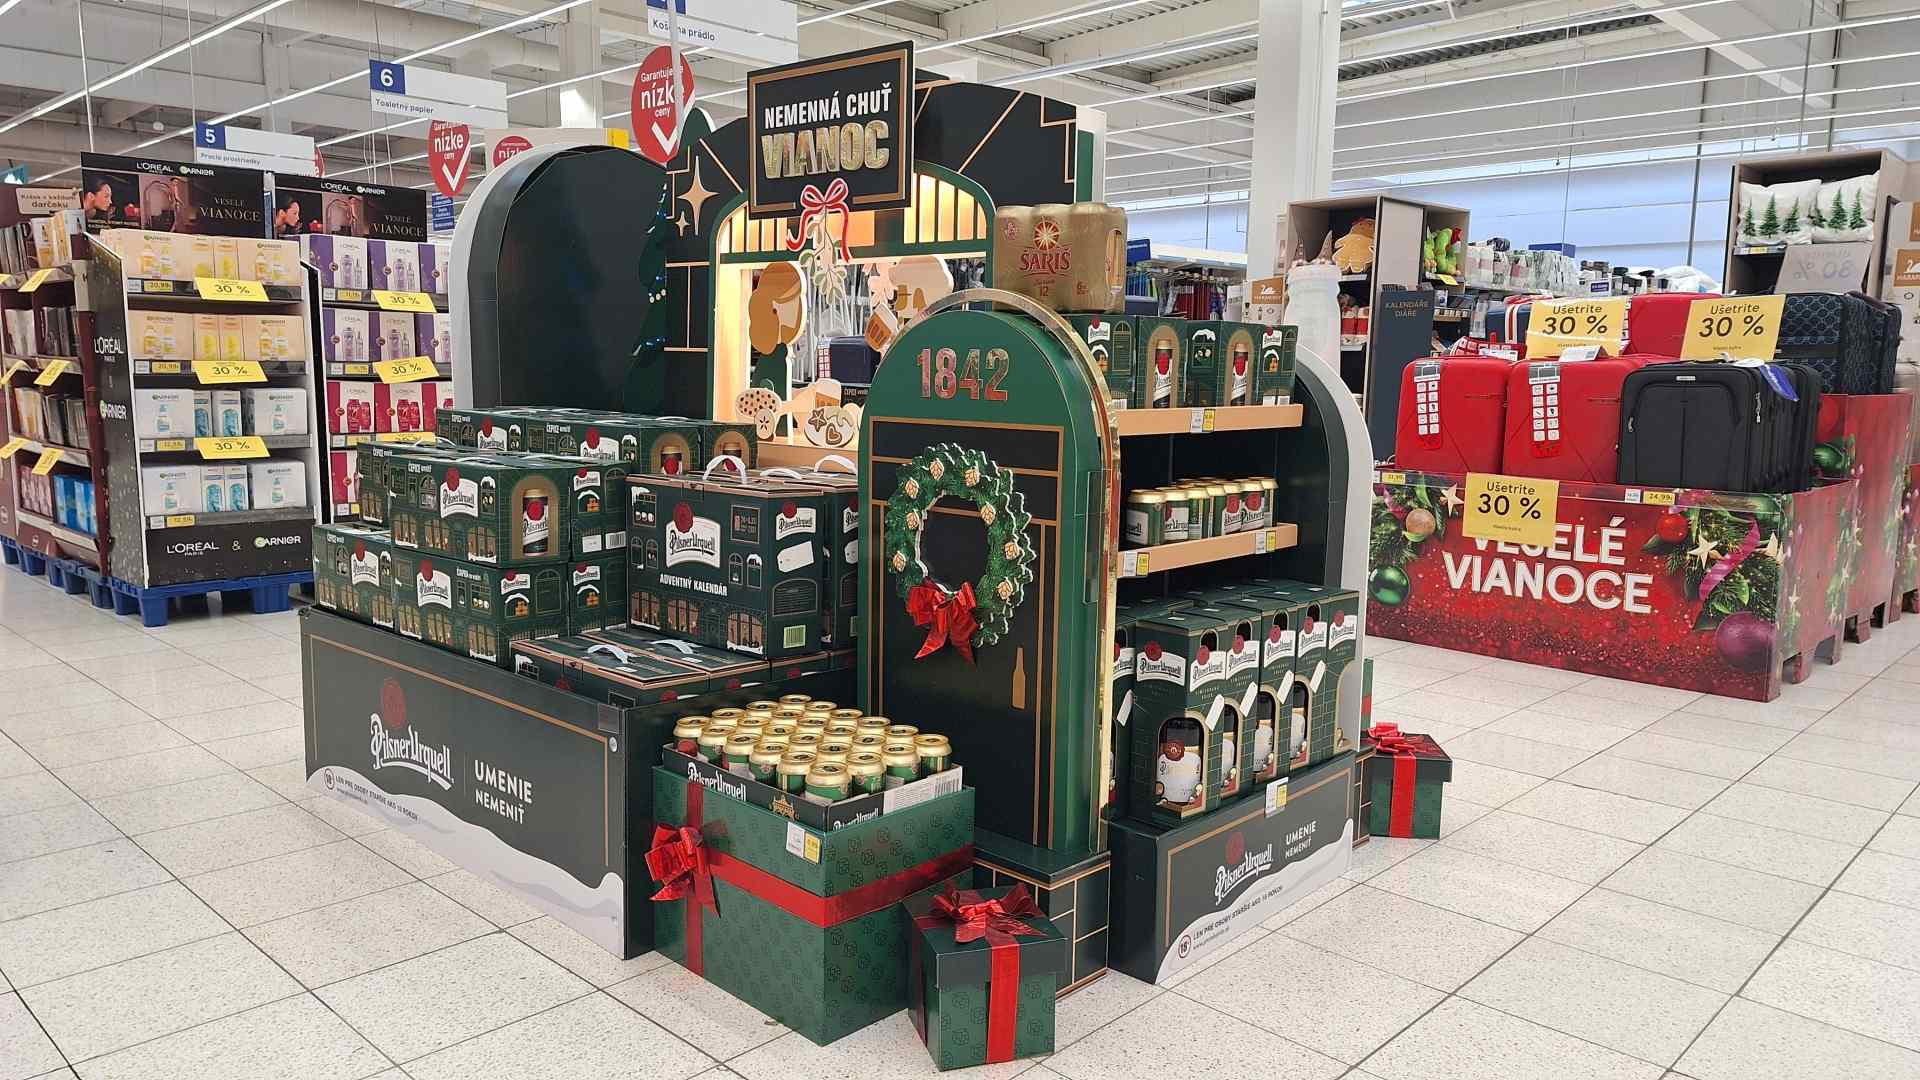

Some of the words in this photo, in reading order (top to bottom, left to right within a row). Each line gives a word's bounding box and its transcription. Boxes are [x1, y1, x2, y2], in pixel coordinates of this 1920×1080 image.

[688, 28, 715, 41] prádlo
[380, 68, 393, 87] 6
[641, 64, 683, 83] Garantujee
[410, 103, 434, 114] papier
[654, 107, 671, 119] ceny
[765, 91, 841, 129] NEMENNÁ
[846, 82, 892, 117] CHUŤ
[205, 129, 216, 144] 5
[761, 119, 890, 180] VIANOC
[200, 207, 261, 222] VIANOCE
[373, 223, 424, 237] VIANOCE
[1019, 247, 1072, 275] ŠARIŠ
[215, 284, 233, 294] 30
[237, 285, 251, 294] %
[390, 296, 405, 304] 30
[409, 296, 421, 304] %
[1553, 304, 1603, 315] Ušetrite
[1710, 303, 1760, 315] Ušetrite
[1543, 316, 1576, 335] 30
[1587, 315, 1608, 335] %
[1699, 316, 1733, 337] 30
[1743, 314, 1764, 336] %
[213, 366, 231, 376] 30
[235, 366, 248, 376] %
[391, 365, 407, 375] 30
[409, 363, 422, 371] %
[917, 347, 1010, 401] 1842
[215, 442, 233, 451] 30
[237, 441, 250, 451] %
[1487, 481, 1536, 496] Ušetrite
[1478, 493, 1510, 516] 30
[1520, 497, 1541, 520] %
[232, 540, 241, 550] &
[254, 536, 301, 548] GARNIER
[669, 529, 693, 555] Pilsner
[692, 530, 715, 556] Urquell
[659, 573, 692, 591] ADVENTNÝ
[694, 580, 728, 597] KALENDÁR
[1442, 550, 1655, 615] VIANOCE
[370, 713, 411, 770] Pilsner
[408, 724, 451, 783] Urquell
[474, 759, 533, 804] UMENIE
[475, 789, 525, 825] NEMENIŤ
[1285, 820, 1317, 846] UMENIE
[1214, 865, 1246, 906] Pilsner
[1244, 843, 1272, 877] Urquell
